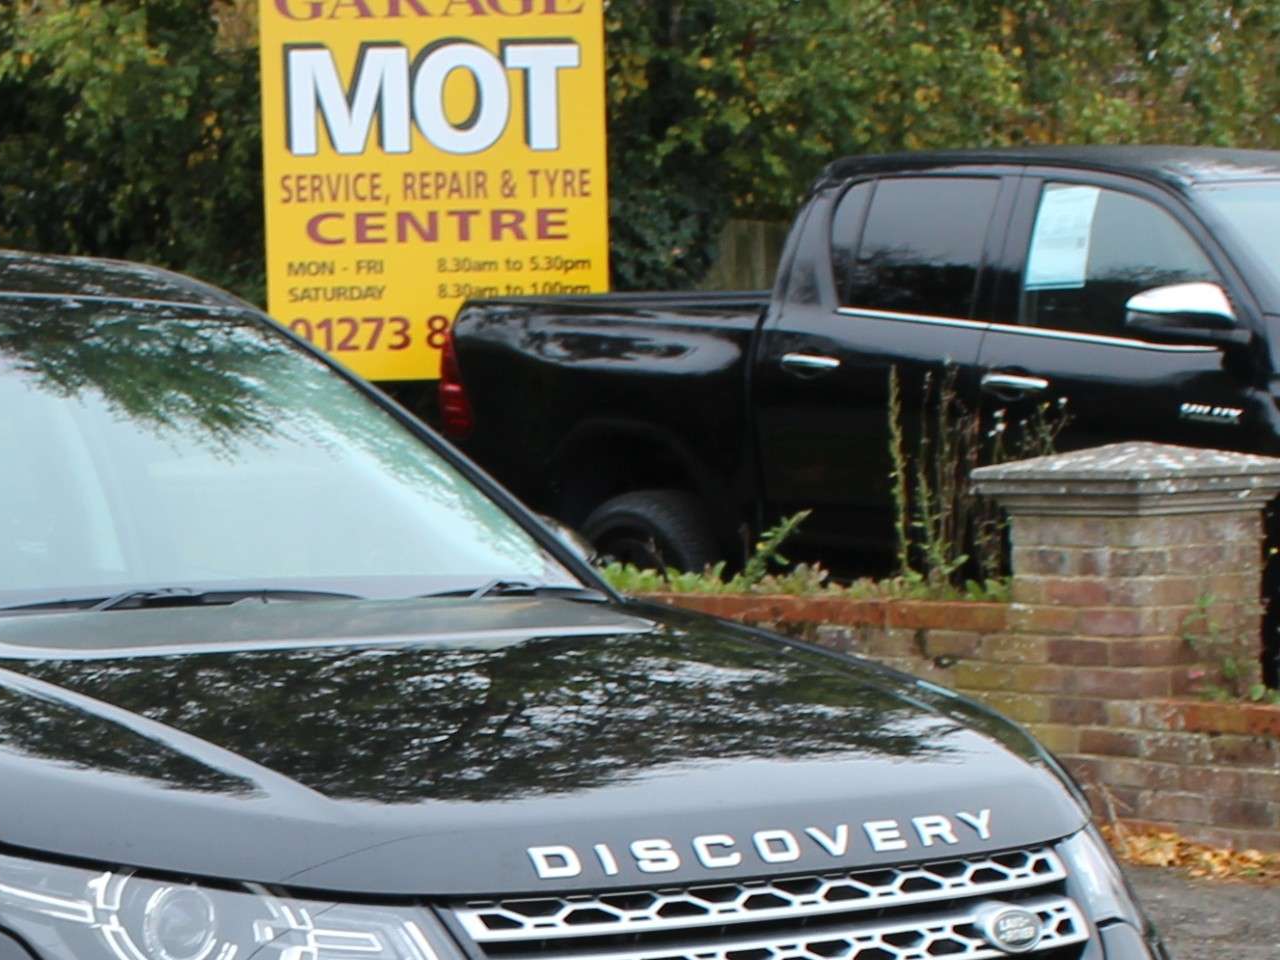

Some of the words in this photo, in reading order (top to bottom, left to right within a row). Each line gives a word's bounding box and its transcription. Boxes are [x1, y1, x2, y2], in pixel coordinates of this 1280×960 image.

[282, 36, 581, 156] MOT
[280, 173, 391, 205] SERVICE,
[403, 170, 489, 200] REPAIR
[500, 169, 518, 198] &
[528, 168, 592, 198] TYRE
[306, 207, 570, 245] CENTRE
[287, 260, 335, 277] MON
[356, 259, 384, 275] FRI
[437, 257, 498, 273] 8.30am
[505, 257, 524, 271] to
[530, 255, 591, 275] 5.30pm
[288, 285, 386, 303] SATURDAY
[505, 284, 524, 296] to
[531, 281, 591, 296] 100pm
[289, 315, 411, 352] 01273
[527, 808, 992, 879] DISCOVERY
